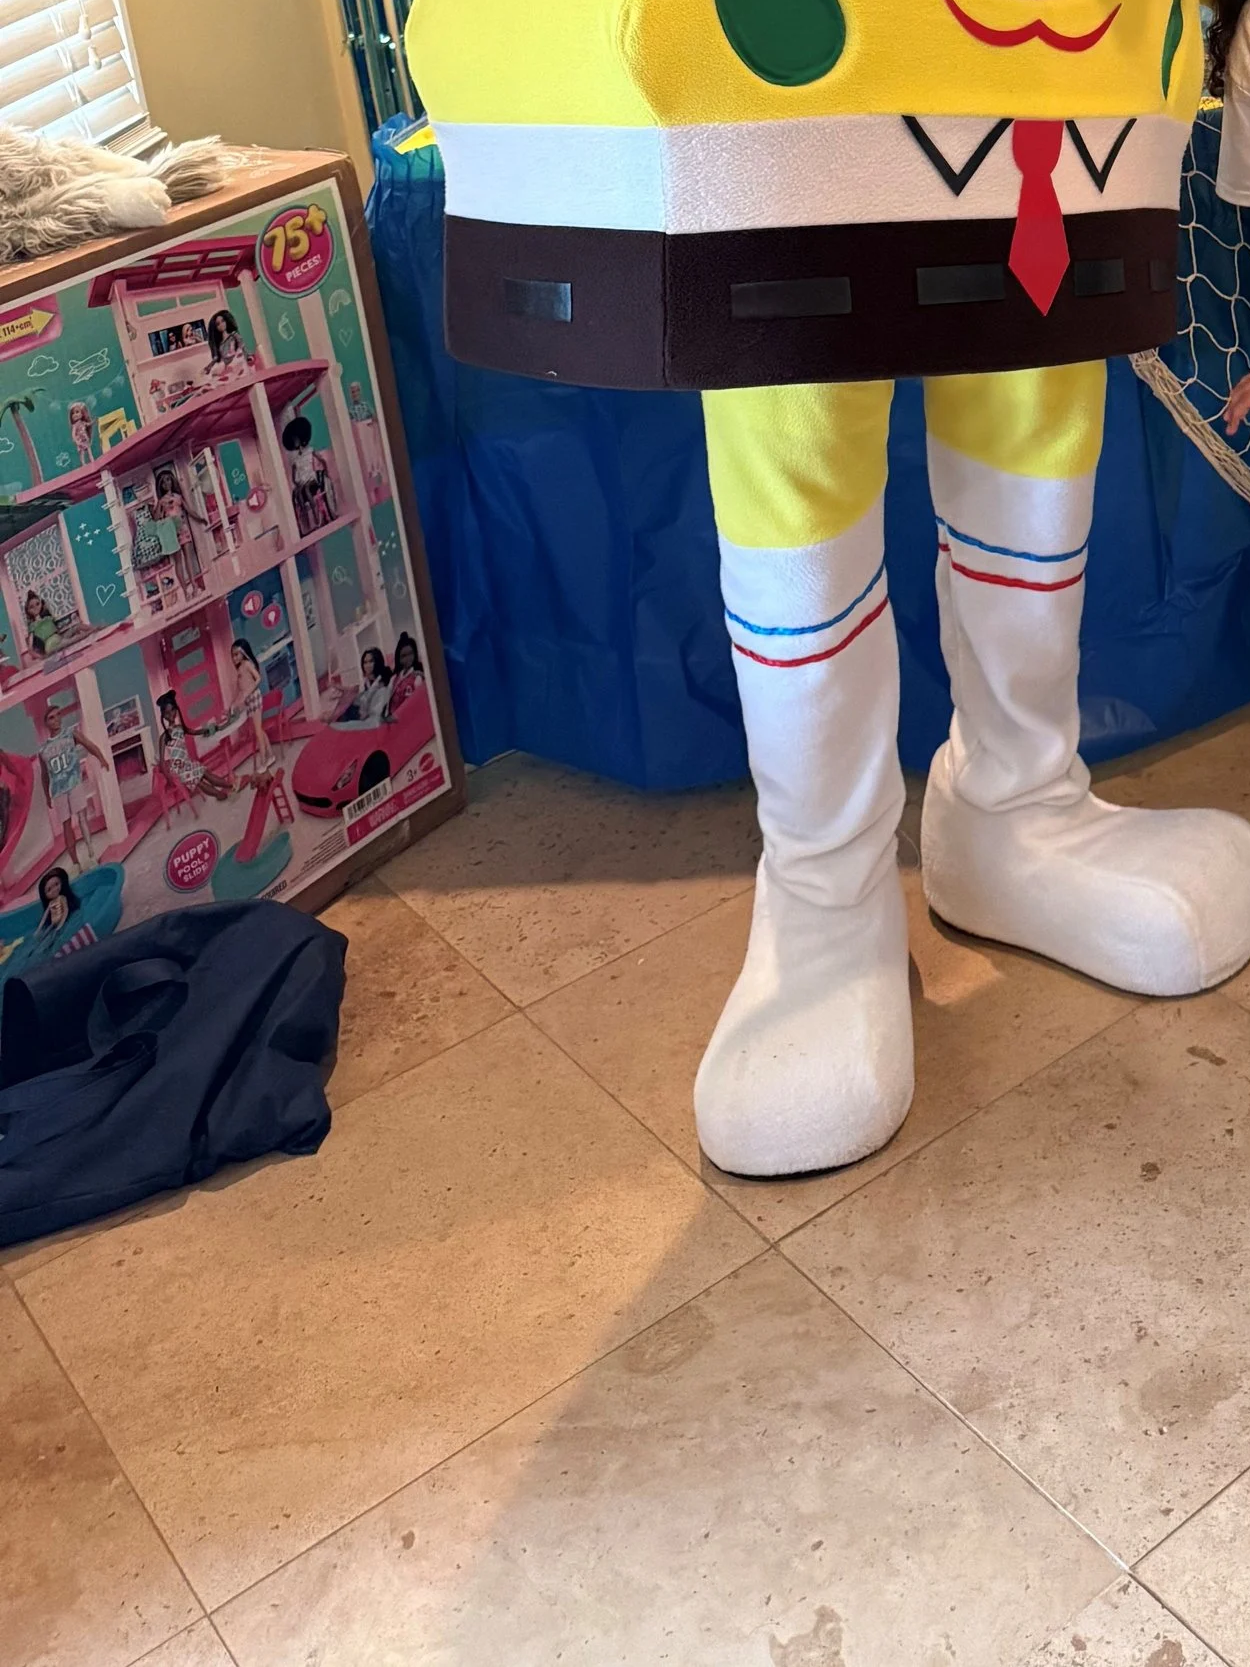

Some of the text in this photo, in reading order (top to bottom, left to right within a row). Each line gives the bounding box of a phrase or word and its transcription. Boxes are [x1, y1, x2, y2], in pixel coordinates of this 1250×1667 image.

[263, 203, 327, 272] 75+
[285, 253, 322, 283] PIECES!
[173, 837, 210, 868] PUPPY
[177, 858, 204, 878] POOL
